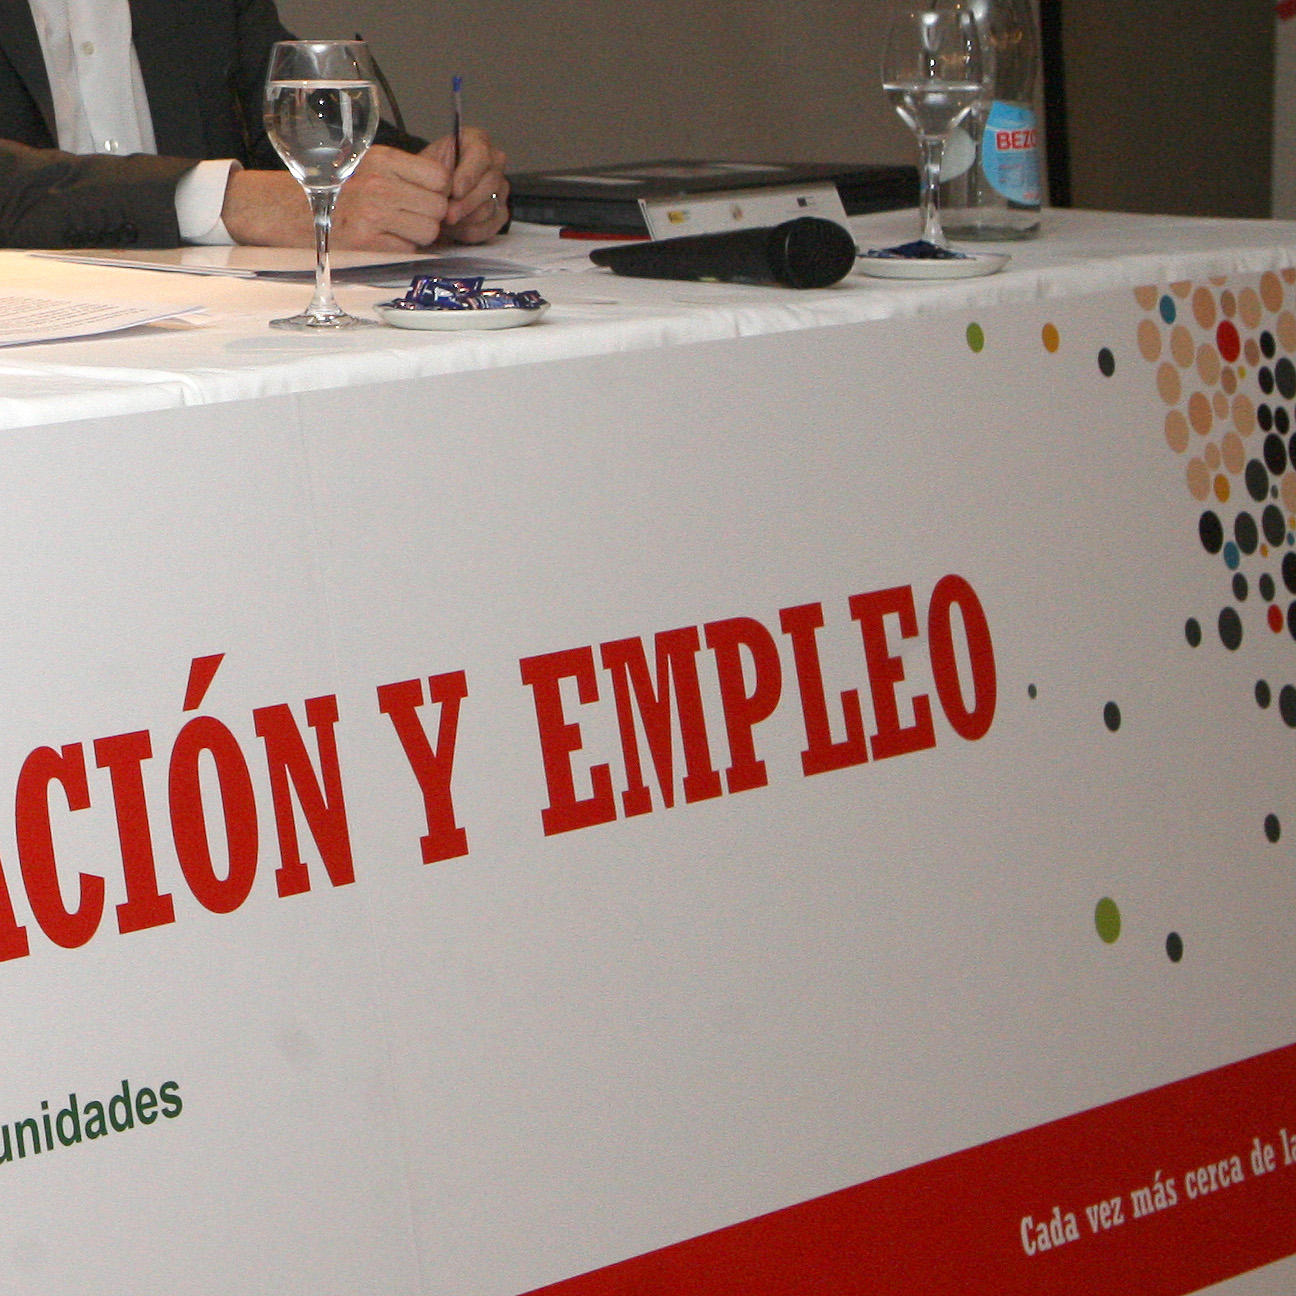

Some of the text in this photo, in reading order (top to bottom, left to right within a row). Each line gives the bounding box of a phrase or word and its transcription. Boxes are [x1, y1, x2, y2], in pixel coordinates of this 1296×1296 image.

[377, 670, 469, 865] Y
[519, 574, 997, 837] EMPLEO
[1020, 1206, 1081, 1256] Cada
[1085, 1196, 1125, 1234] vez
[1130, 1170, 1179, 1219] más
[1184, 1155, 1245, 1199] cerca
[1250, 1137, 1276, 1175] de
